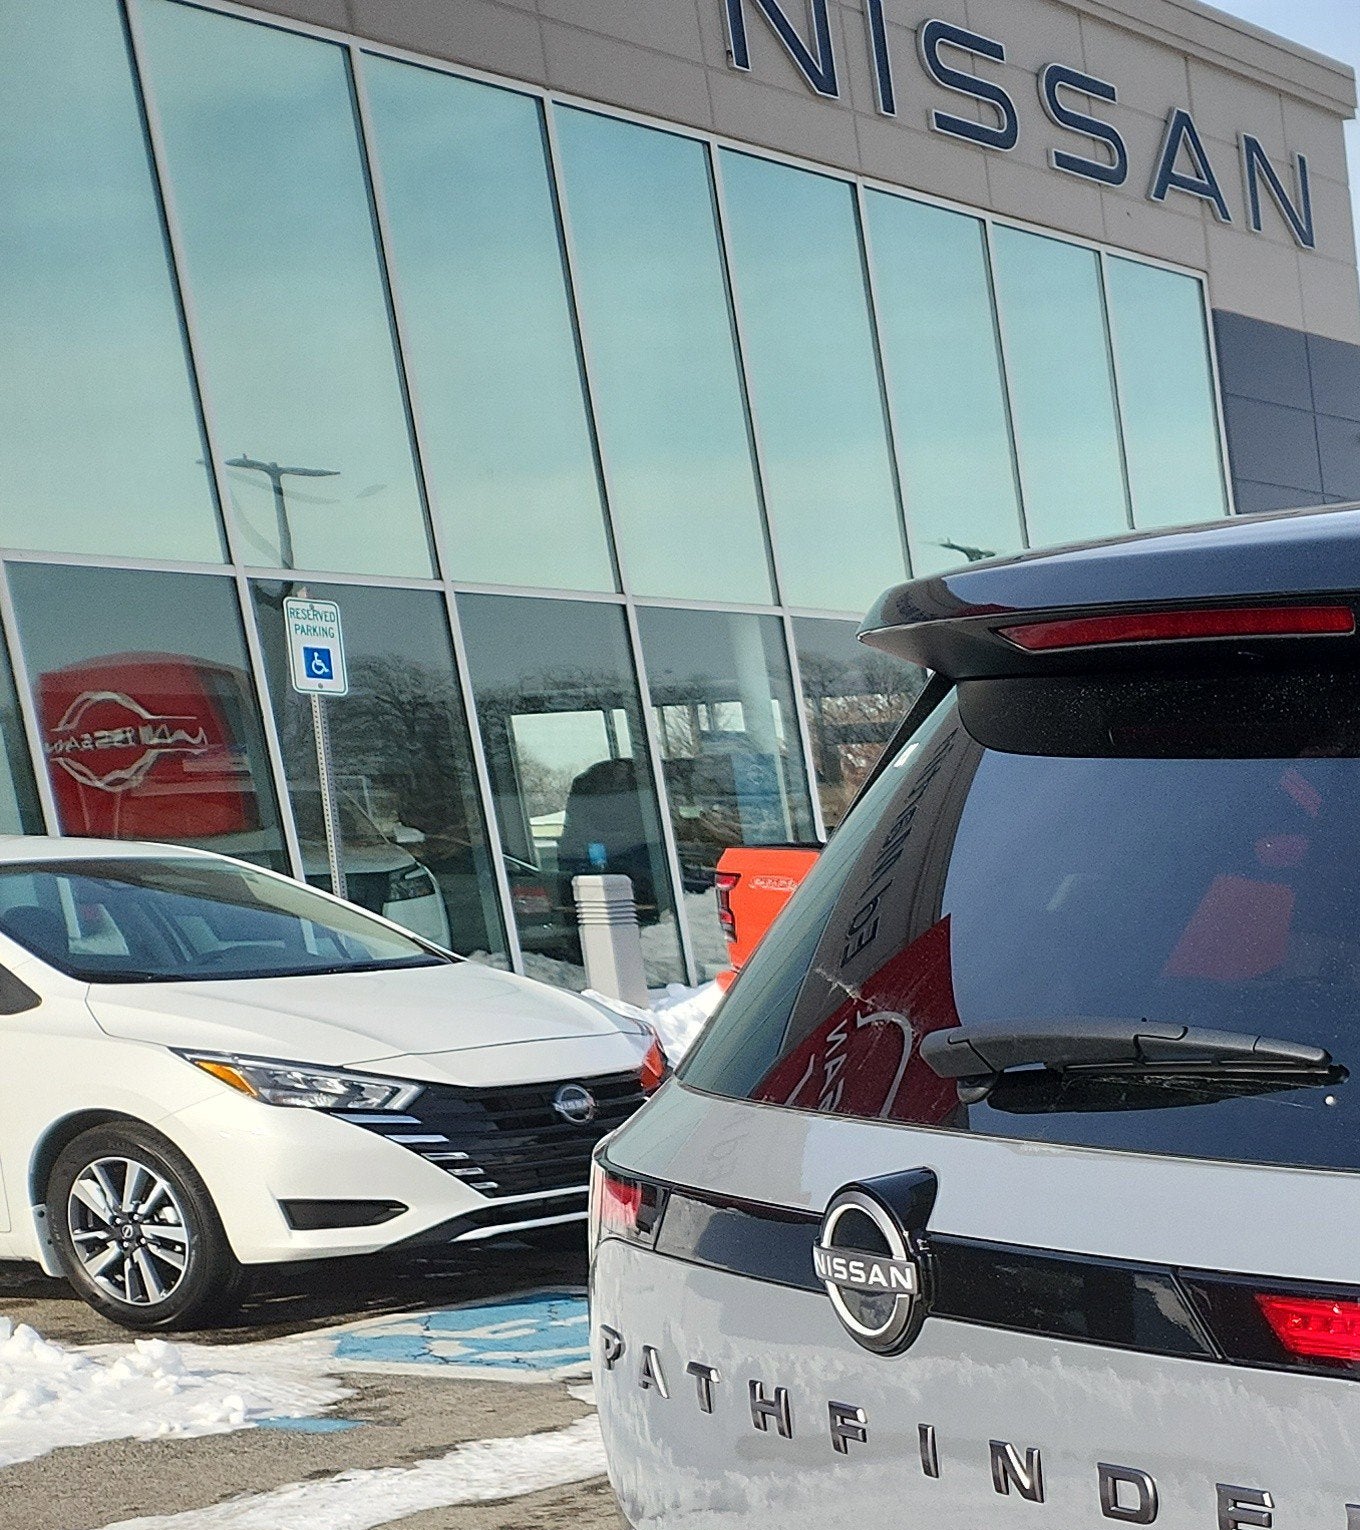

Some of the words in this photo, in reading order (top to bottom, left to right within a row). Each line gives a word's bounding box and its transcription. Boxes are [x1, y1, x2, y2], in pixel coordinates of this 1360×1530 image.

[722, 0, 1317, 250] NISSAN
[289, 607, 336, 623] RESERVED
[294, 623, 335, 639] PARKING
[813, 1248, 913, 1293] NISSAN
